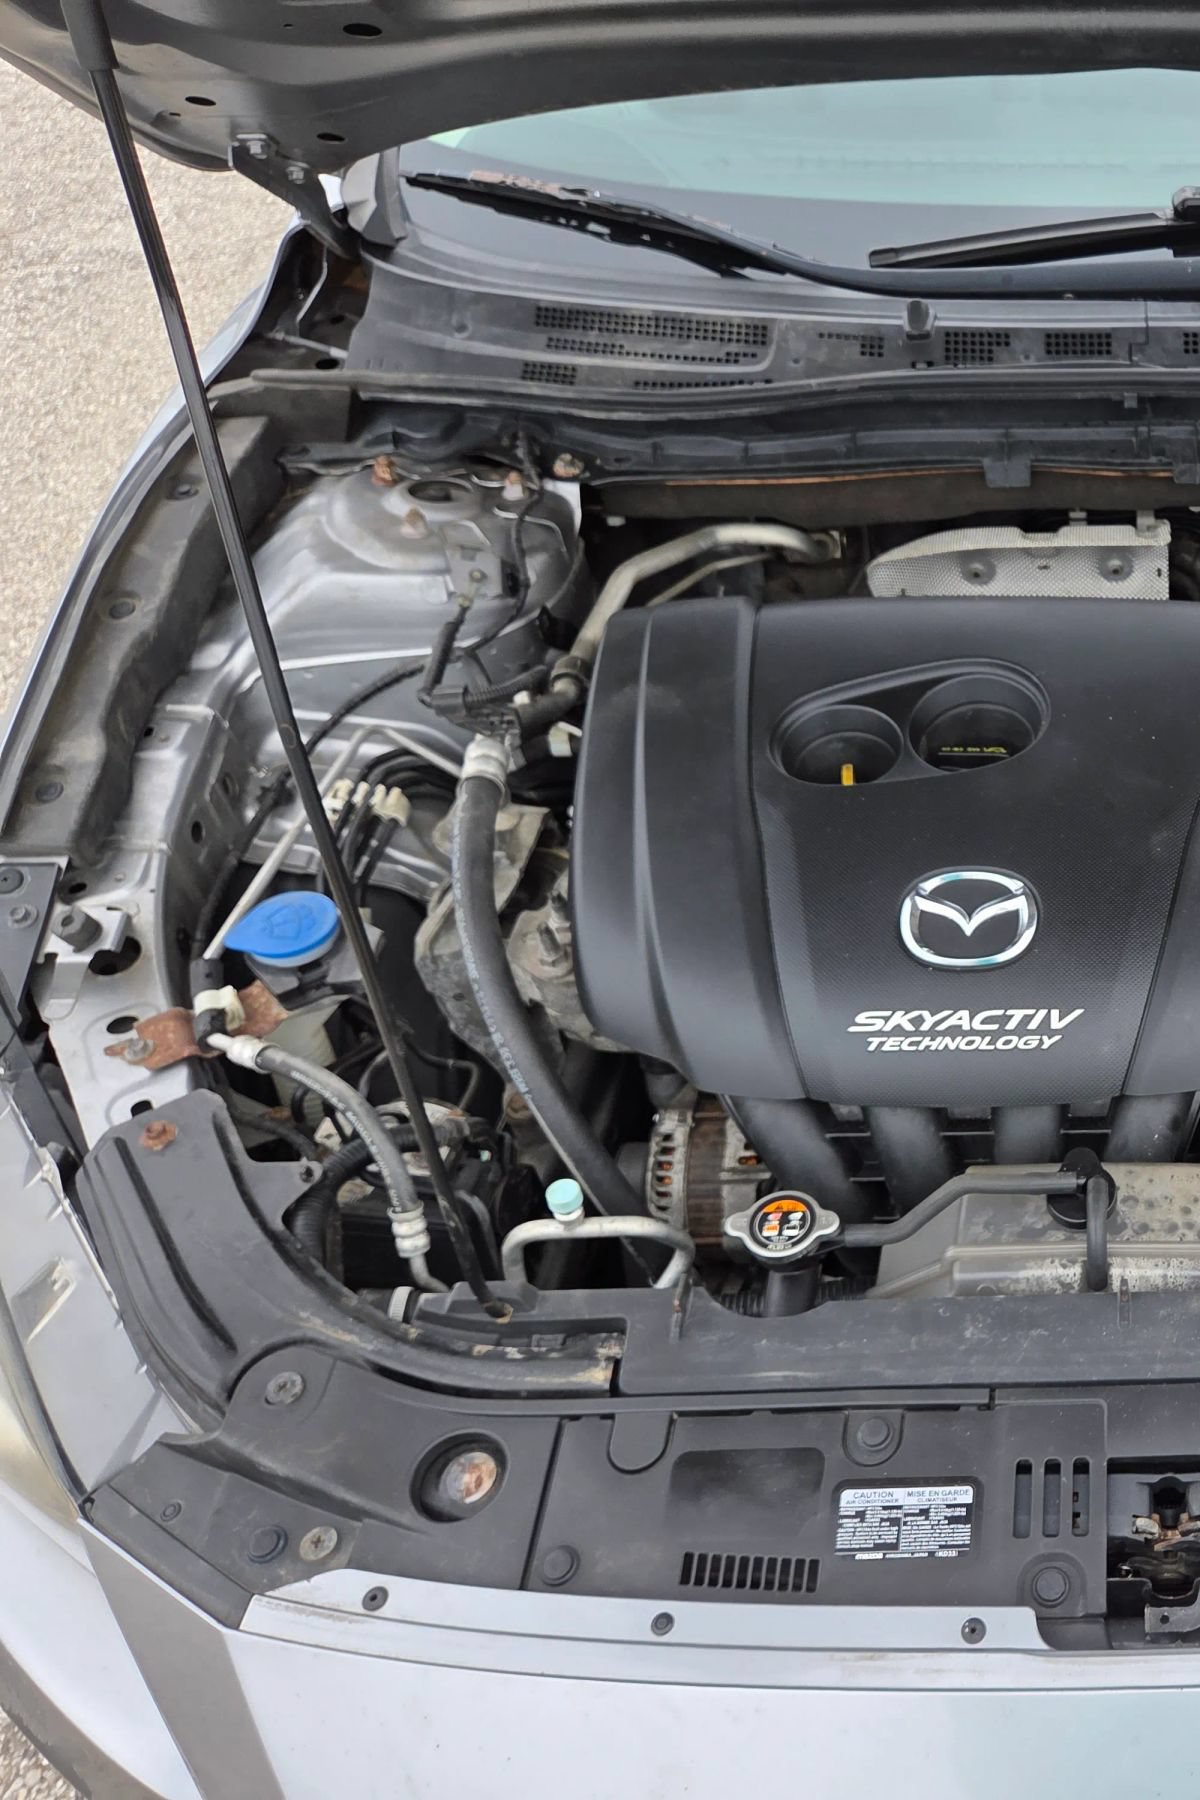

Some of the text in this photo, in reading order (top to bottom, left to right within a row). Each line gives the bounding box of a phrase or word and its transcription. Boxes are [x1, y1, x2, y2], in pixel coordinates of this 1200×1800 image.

[847, 1009, 1085, 1032] SKYACTIV
[866, 1035, 1062, 1051] TECHNOLOGY
[853, 1490, 894, 1499] CAUTION
